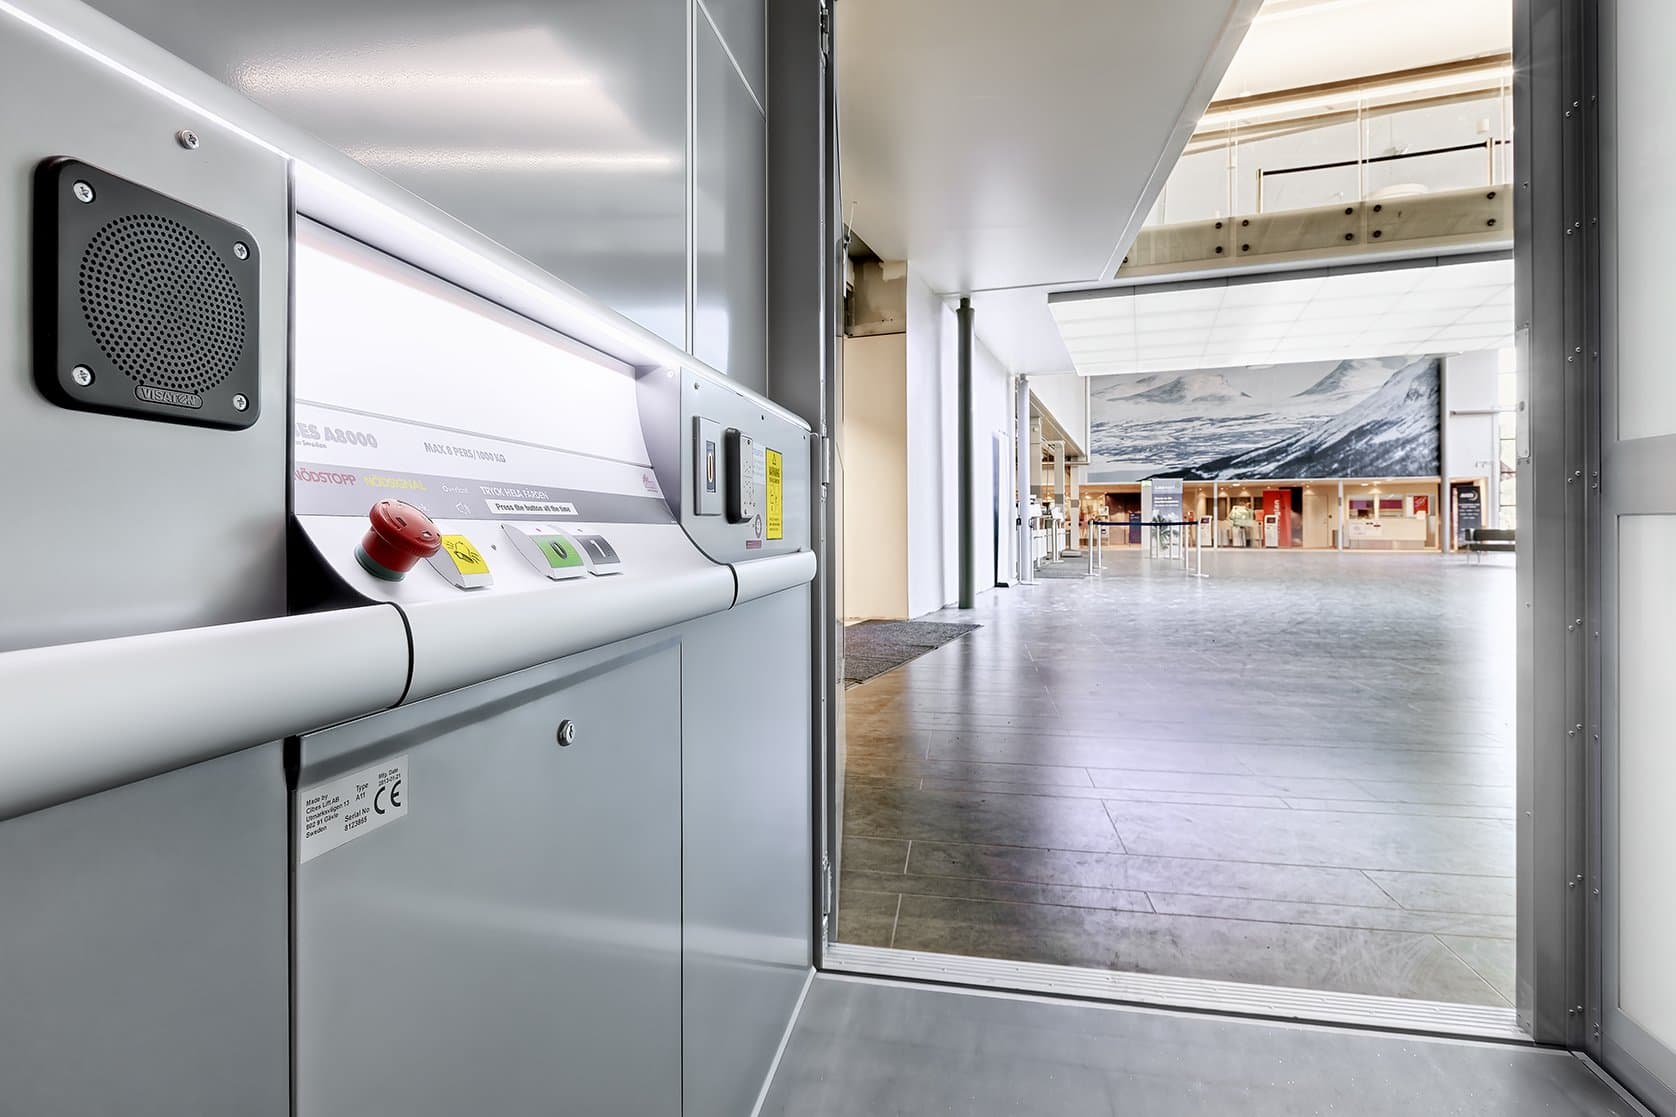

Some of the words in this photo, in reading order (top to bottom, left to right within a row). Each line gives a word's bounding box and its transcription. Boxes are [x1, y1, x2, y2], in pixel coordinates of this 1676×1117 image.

[324, 426, 377, 448] A8000
[424, 442, 446, 453] MAX
[295, 467, 356, 485] NÖDSTOPP
[495, 503, 514, 511] Press
[356, 782, 368, 793] Type
[306, 803, 322, 814] Cibes
[344, 809, 361, 822] Serial
[306, 825, 328, 839] Sweden
